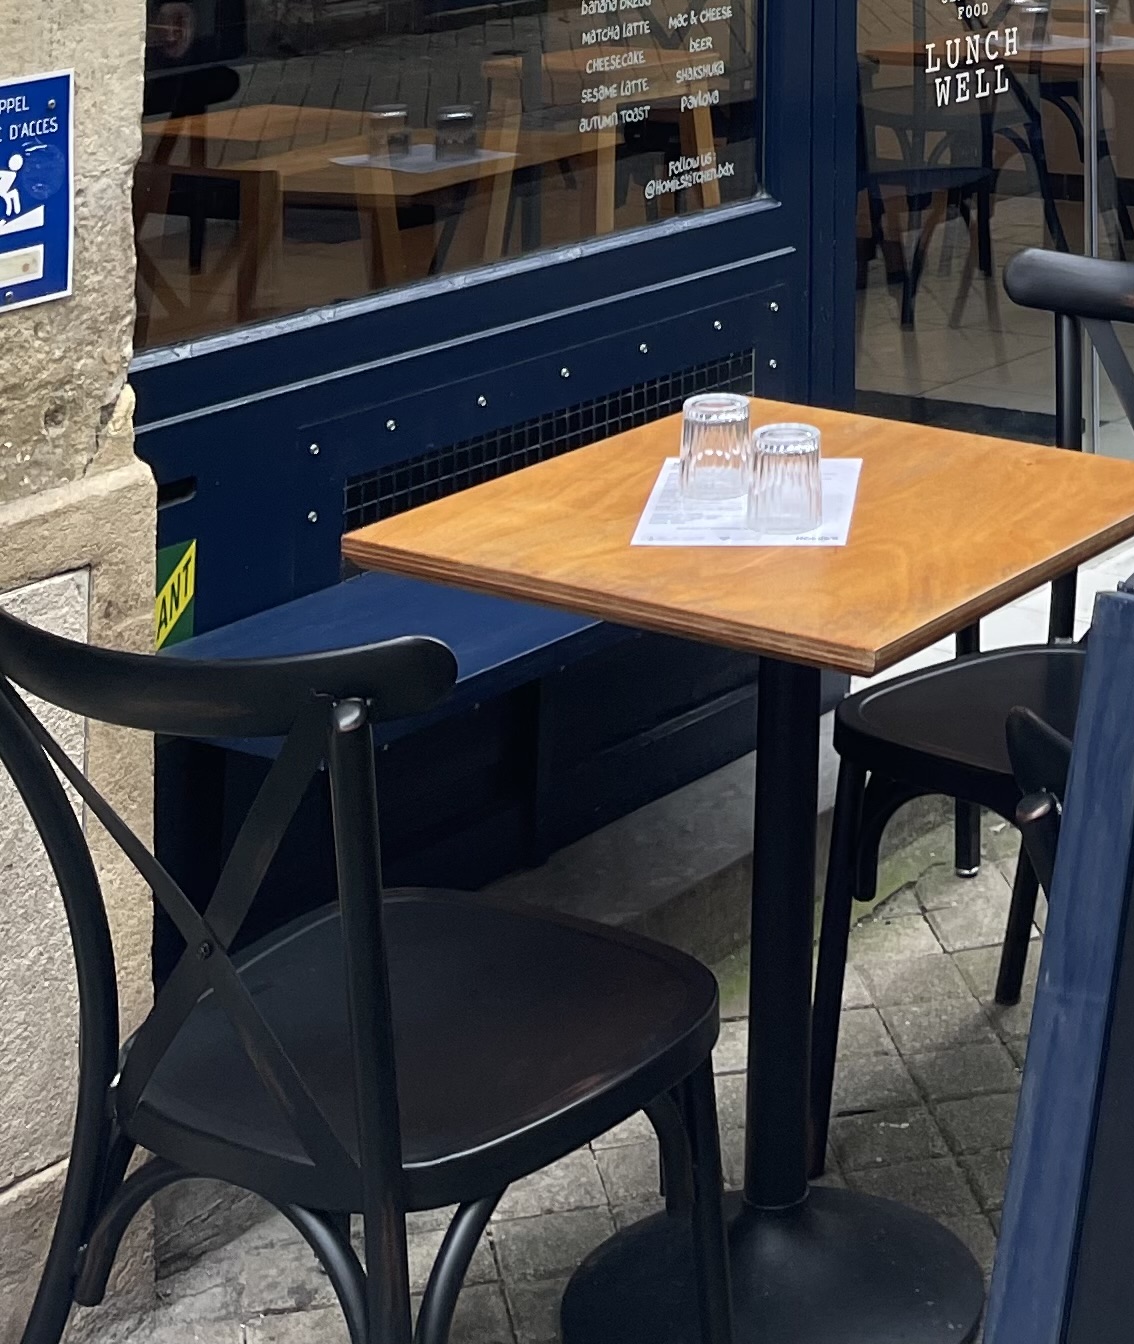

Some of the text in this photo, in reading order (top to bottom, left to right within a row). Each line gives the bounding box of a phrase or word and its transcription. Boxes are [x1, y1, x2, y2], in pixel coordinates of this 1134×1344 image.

[956, 2, 989, 21] FOOD
[924, 26, 1020, 75] LUNCH
[934, 63, 1011, 109] WELL
[9, 116, 59, 141] D'ACCES
